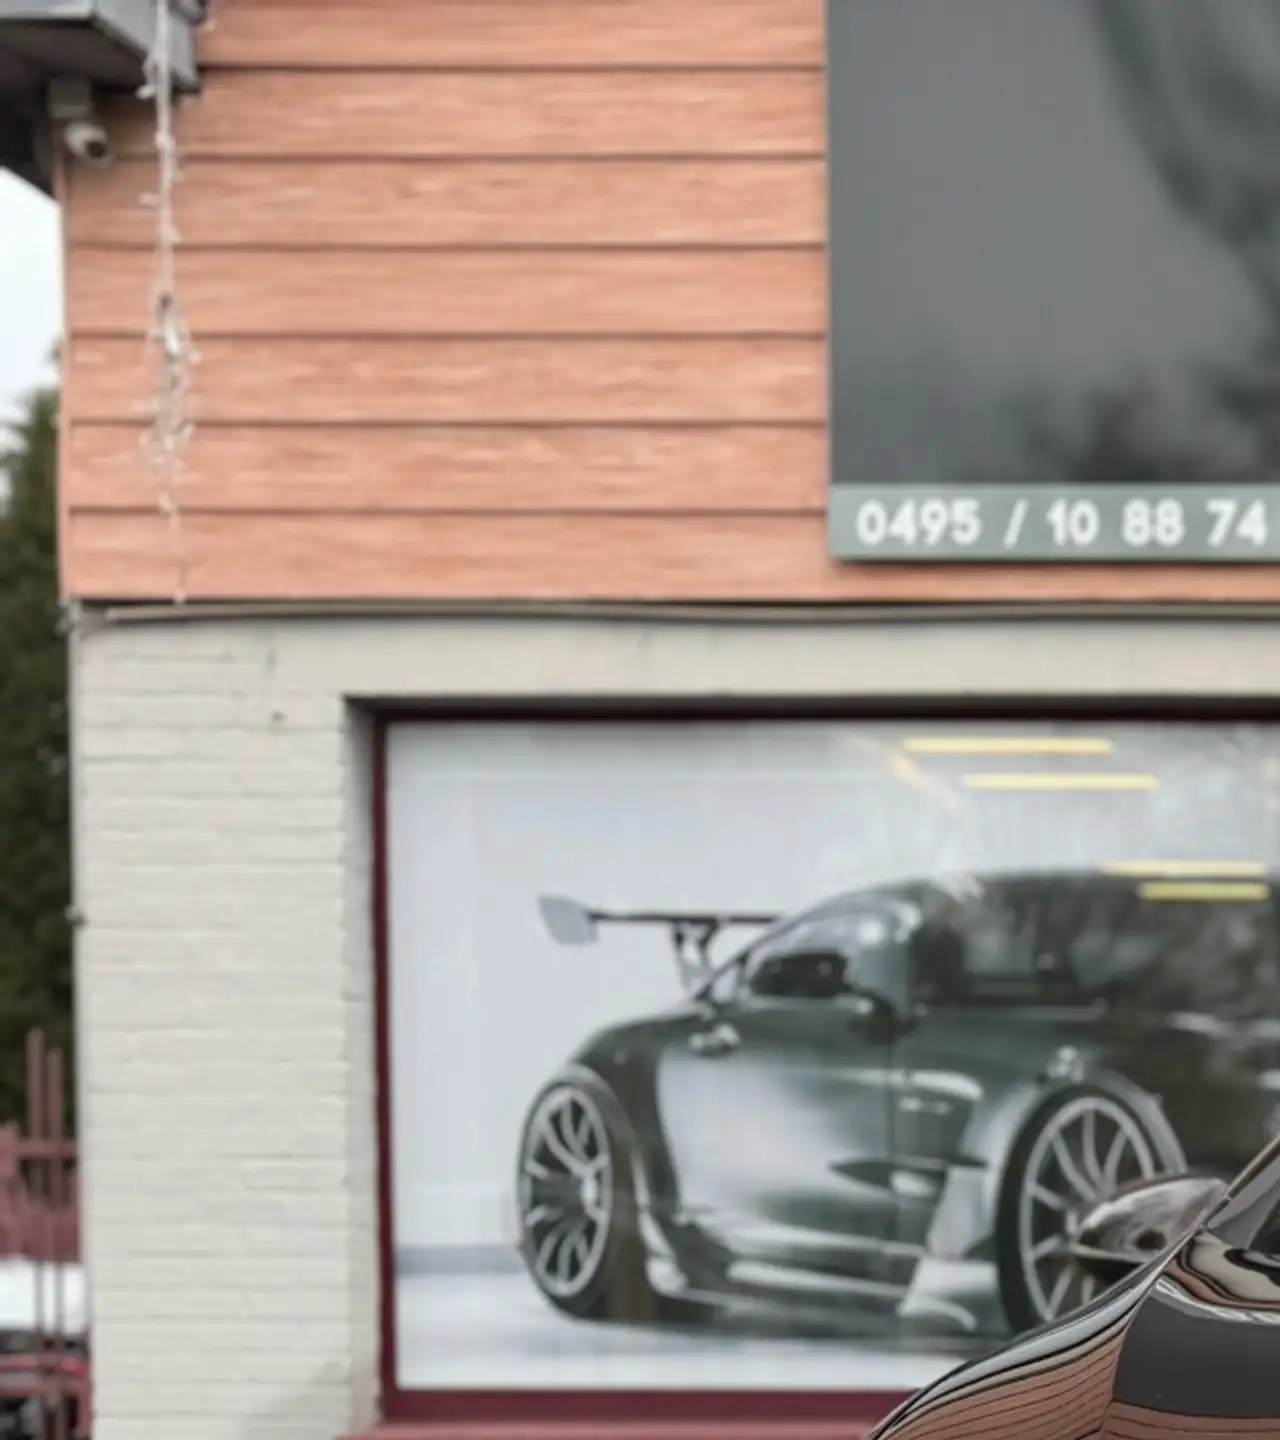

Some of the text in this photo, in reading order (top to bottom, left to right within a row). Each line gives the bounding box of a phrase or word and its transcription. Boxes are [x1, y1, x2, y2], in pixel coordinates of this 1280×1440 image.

[855, 498, 1269, 548] 0495 / 10 88 74
